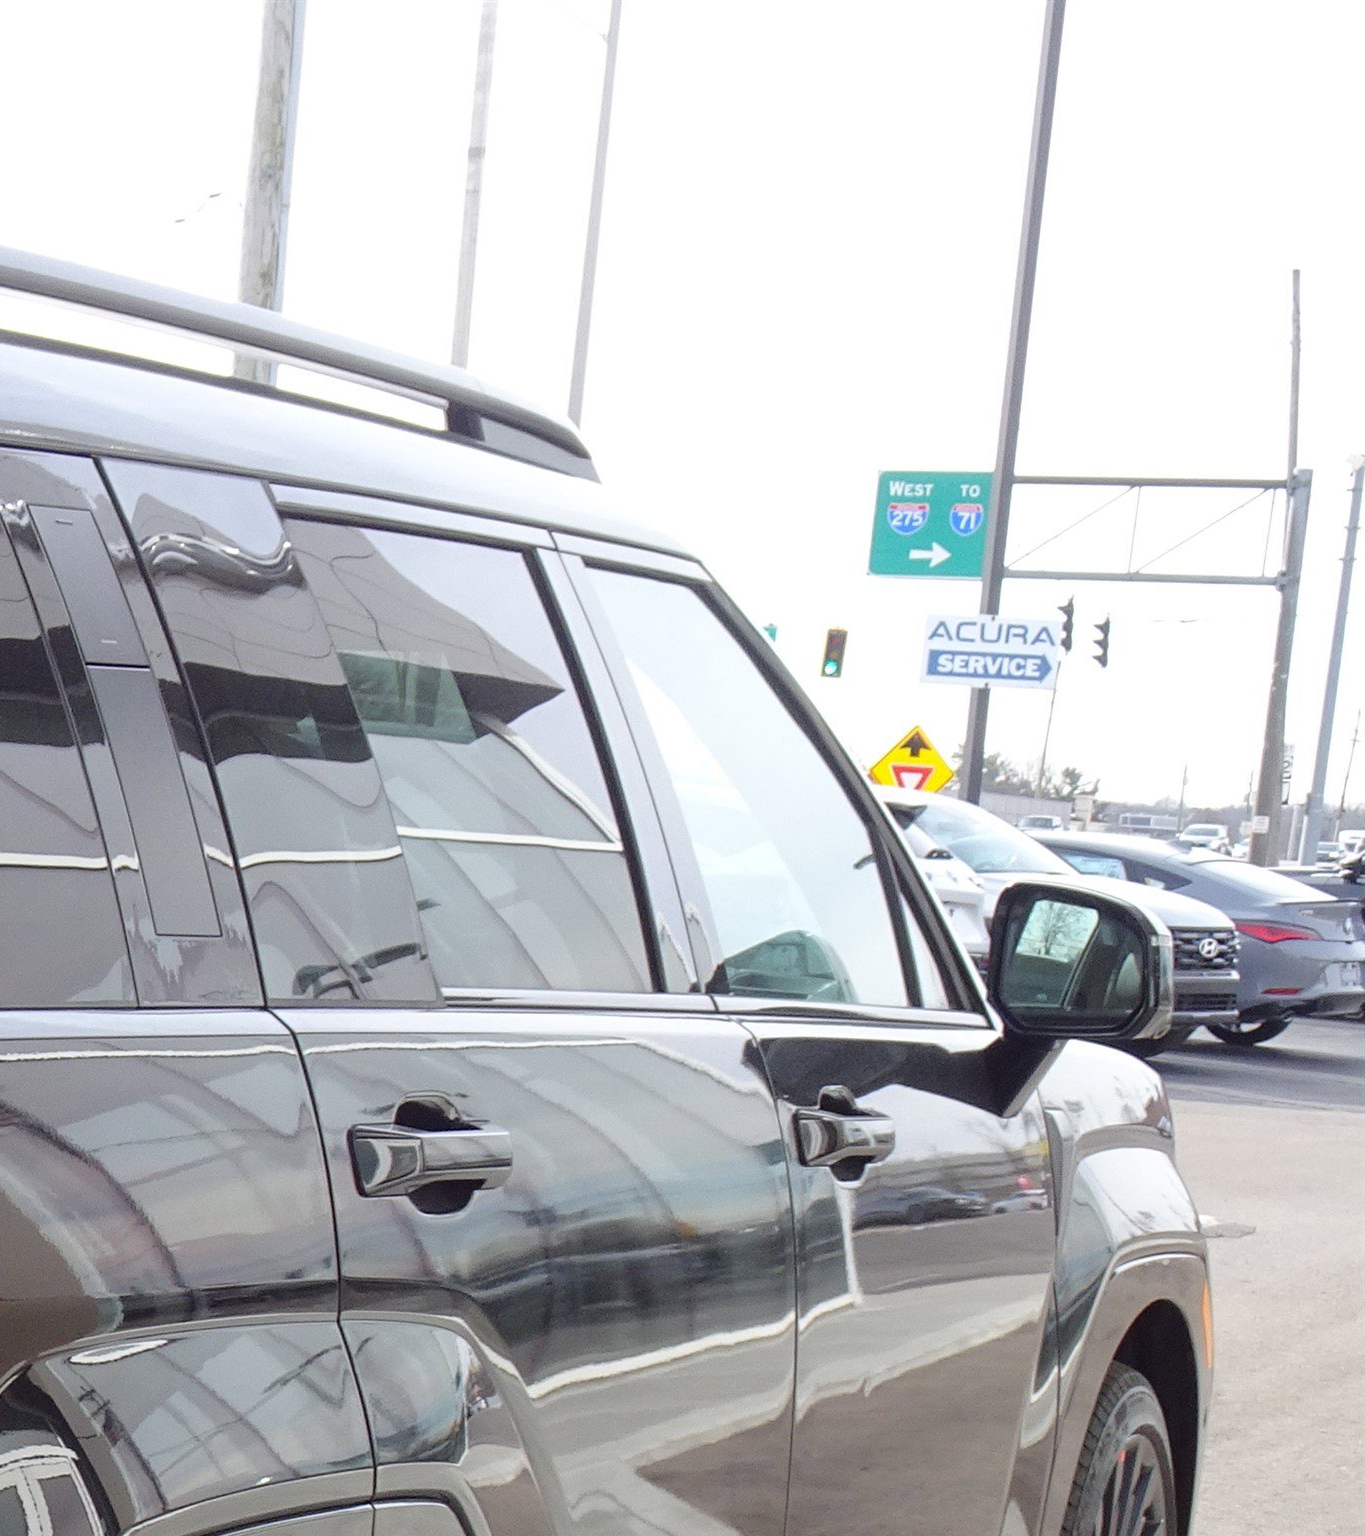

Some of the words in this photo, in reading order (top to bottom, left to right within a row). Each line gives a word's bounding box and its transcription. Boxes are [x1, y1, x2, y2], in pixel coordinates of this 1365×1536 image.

[889, 481, 934, 496] WEST
[960, 485, 981, 498] TO
[892, 511, 924, 527] 275
[957, 511, 977, 530] 71
[928, 620, 1056, 647] ACURA
[936, 653, 1042, 677] SERVICE
